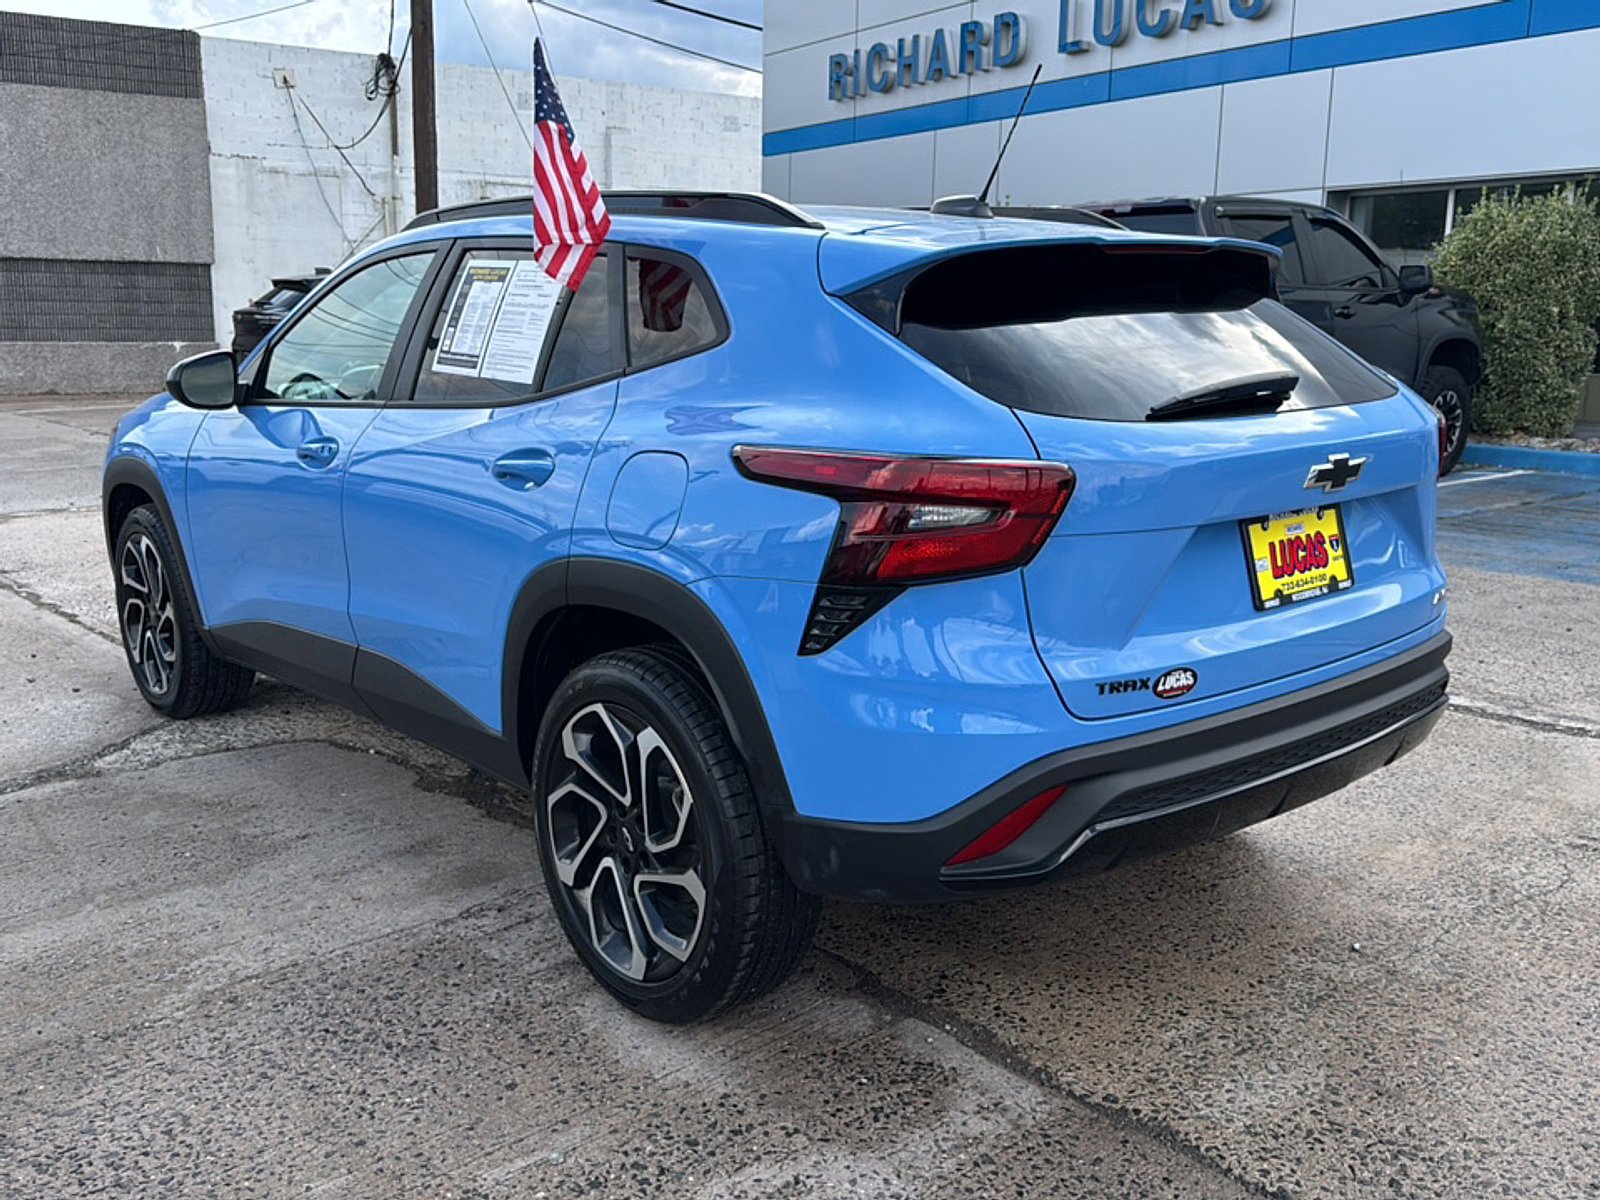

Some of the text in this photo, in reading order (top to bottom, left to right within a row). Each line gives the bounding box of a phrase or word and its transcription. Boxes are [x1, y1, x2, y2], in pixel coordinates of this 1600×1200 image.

[829, 0, 1267, 100] RICHARD LUC
[1269, 530, 1329, 579] LUCAS
[1095, 677, 1151, 695] TRAX
[1157, 670, 1195, 691] LUCAS
